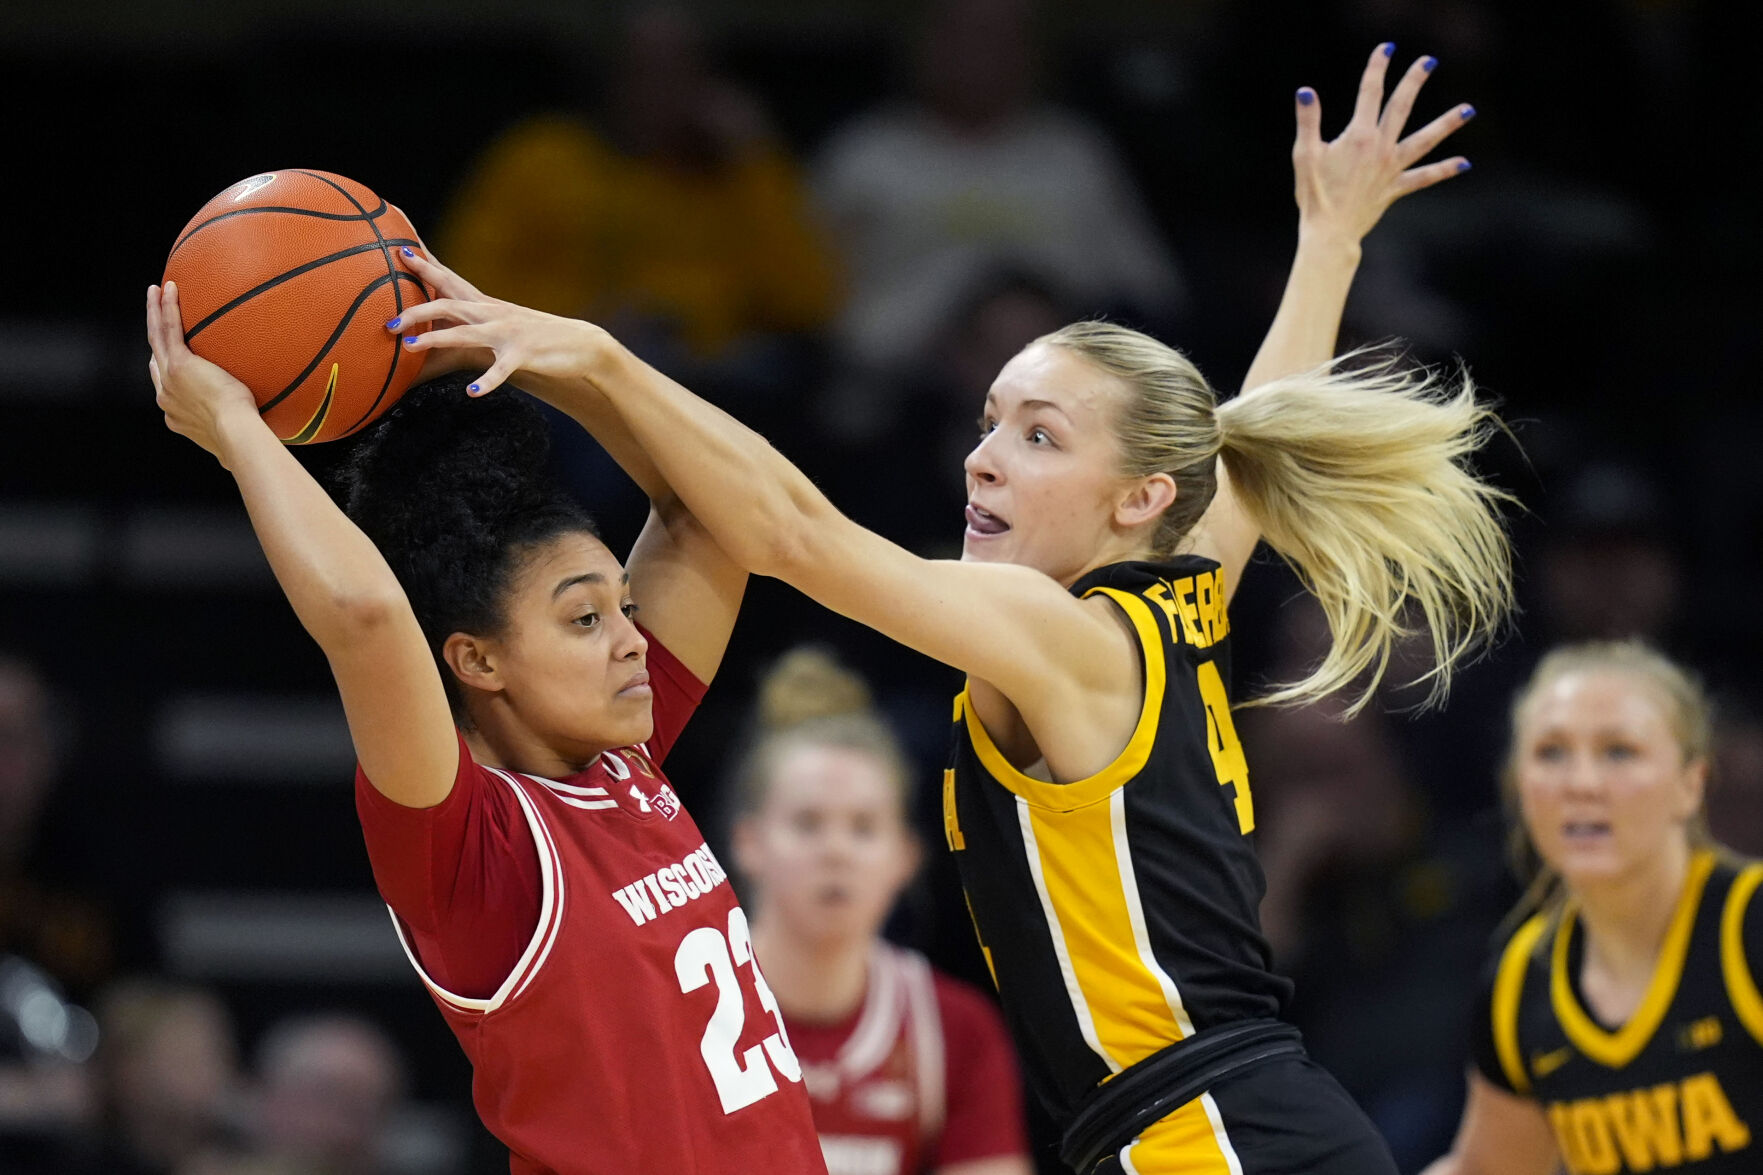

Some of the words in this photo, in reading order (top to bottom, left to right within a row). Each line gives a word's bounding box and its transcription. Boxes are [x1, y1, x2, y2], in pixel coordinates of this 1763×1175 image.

[1197, 660, 1255, 835] 4
[674, 906, 803, 1115] 23
[1552, 1071, 1750, 1175] IOWA
